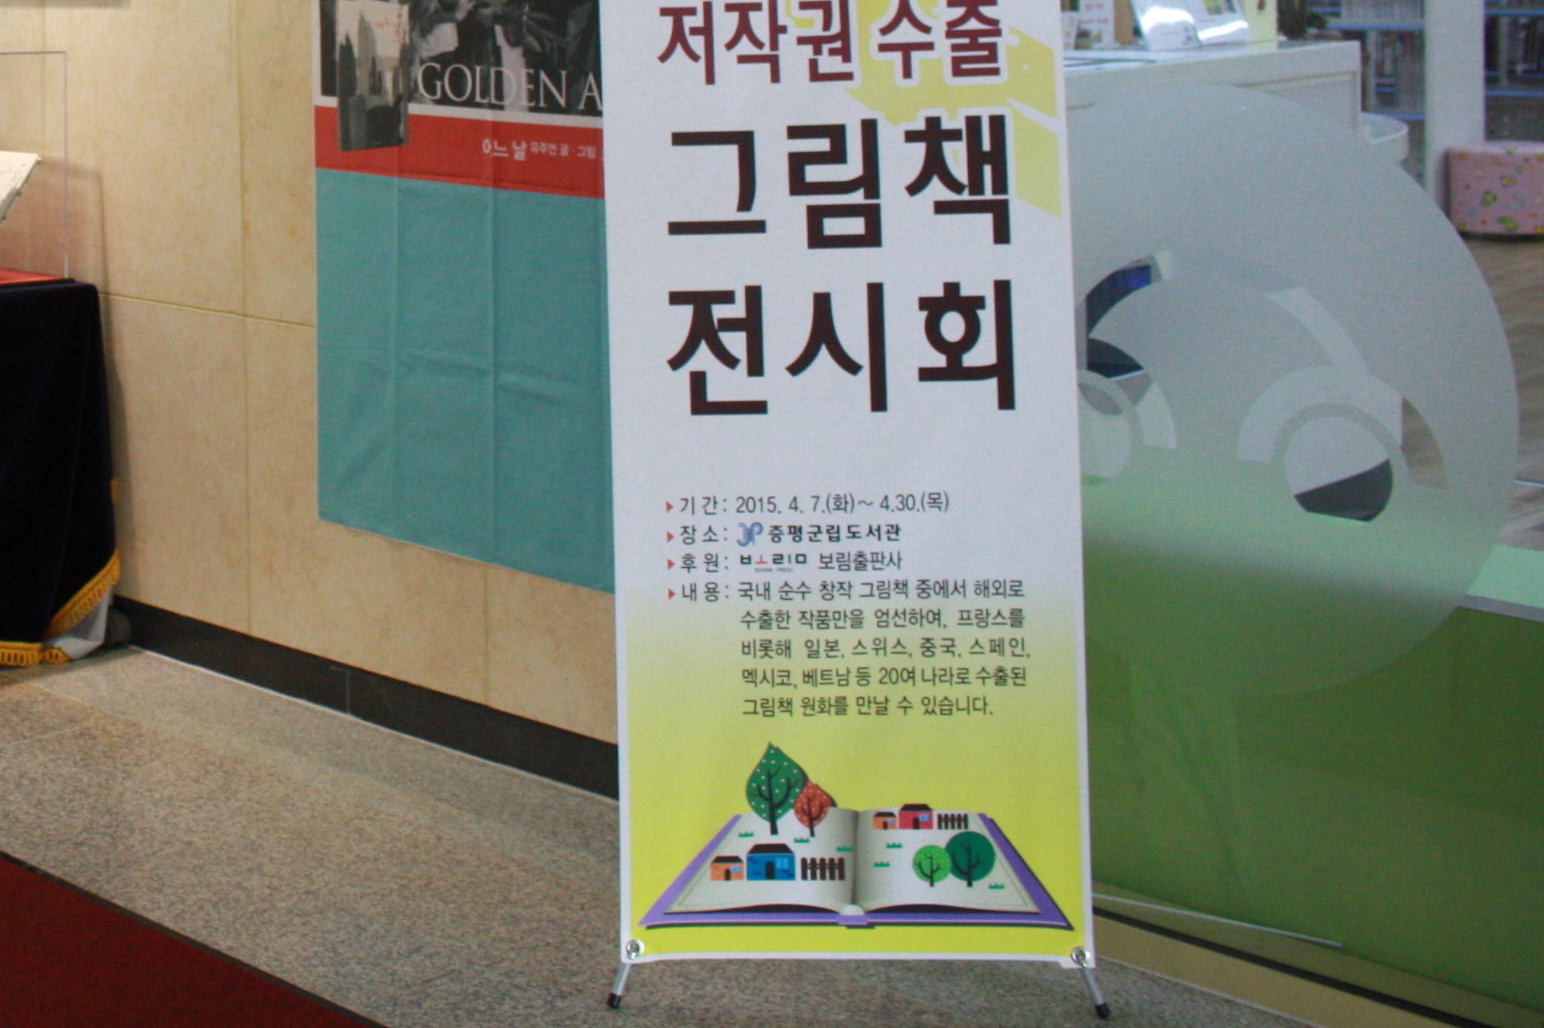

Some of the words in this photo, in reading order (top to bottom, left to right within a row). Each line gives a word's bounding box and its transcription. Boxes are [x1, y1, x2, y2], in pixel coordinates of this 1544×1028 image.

[417, 62, 568, 108] GOLDEN
[512, 140, 527, 162] 날
[668, 113, 1011, 250] 그림책
[666, 279, 1016, 415] 전시회
[736, 495, 782, 515] 2015.
[788, 495, 804, 514] 4.
[769, 524, 901, 544] 증평군립도서관
[818, 551, 902, 572] 보림출판사
[738, 581, 771, 602] 국내
[778, 580, 812, 601] 순수
[819, 580, 853, 602] 창작
[859, 579, 909, 600] 그림책
[915, 578, 967, 599] 중에서
[974, 578, 1025, 599] 해외로
[740, 609, 791, 630] 수출한
[798, 608, 865, 630] 작품만을
[874, 607, 947, 629] 엄선하여,
[957, 607, 1025, 629] 프랑스를
[741, 638, 792, 659] 비롯해
[852, 637, 913, 659] 스위스,
[920, 637, 962, 658] 중국,
[969, 637, 1030, 658] 스페인,
[742, 668, 798, 689] 멕시코,
[802, 667, 852, 688] 베트남
[855, 666, 872, 687] 등
[878, 666, 915, 687] 20여
[921, 666, 972, 687] 나라로
[975, 665, 1026, 687] 수출된
[742, 697, 793, 717] 그림책
[800, 695, 849, 717] 원화를
[856, 695, 890, 716] 만날
[897, 695, 913, 716] 수
[921, 695, 993, 716] 있습니다.
